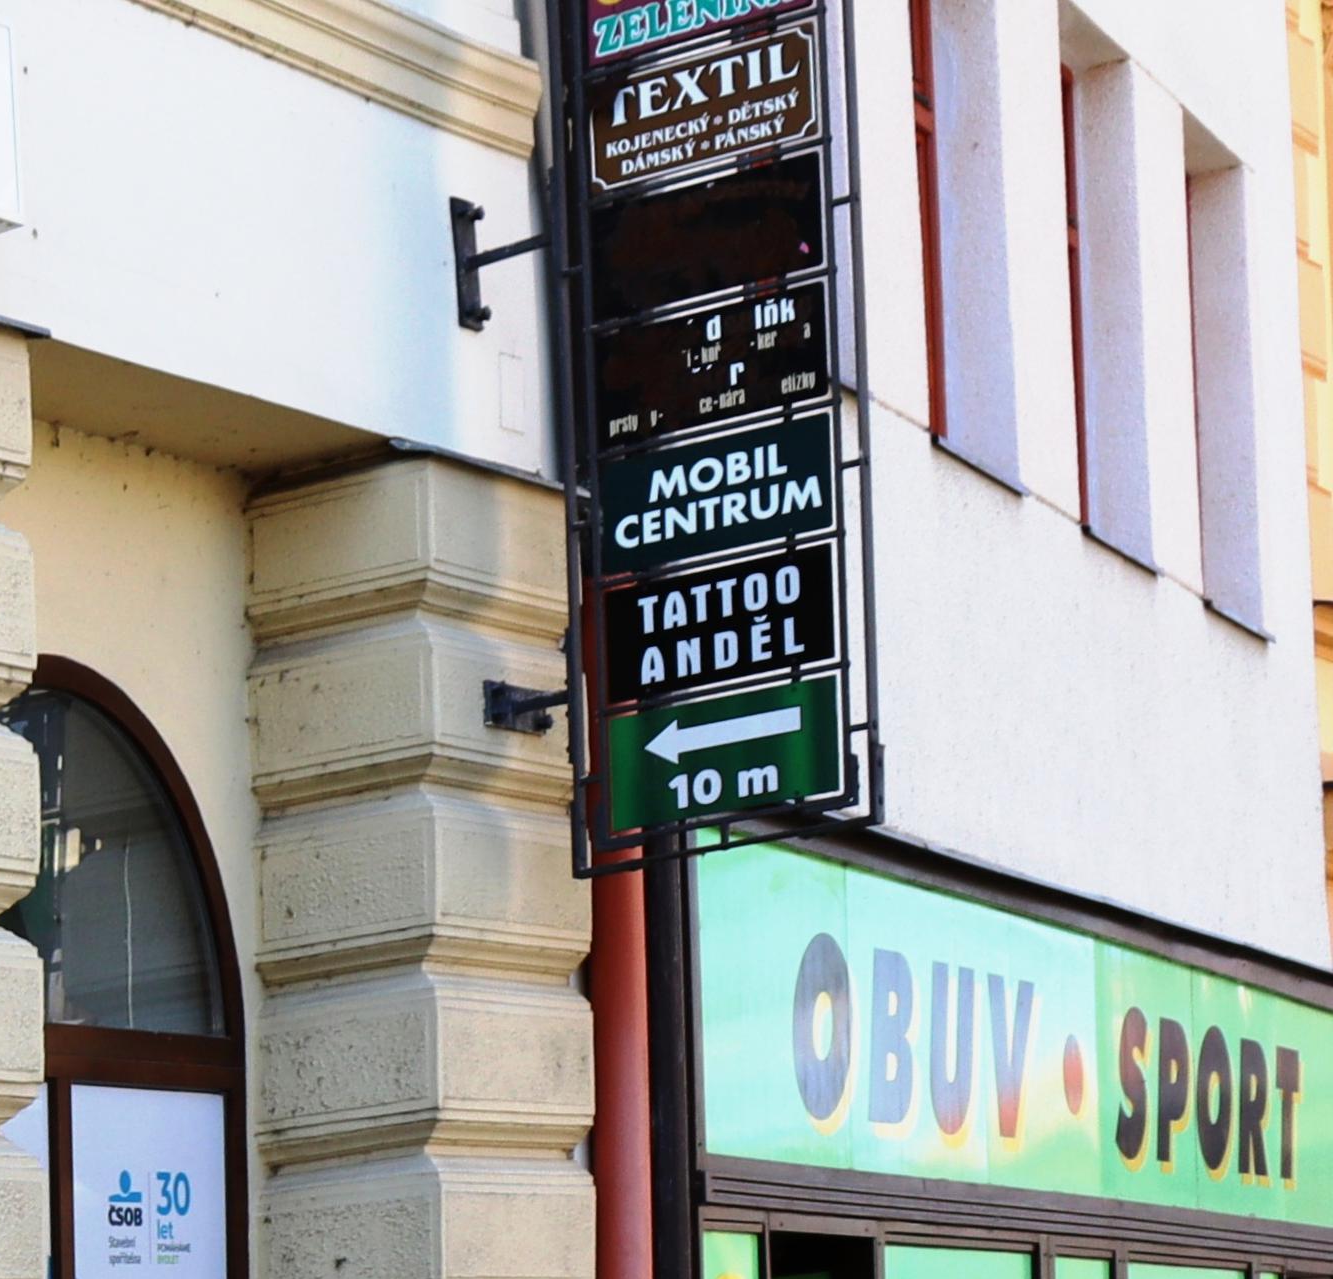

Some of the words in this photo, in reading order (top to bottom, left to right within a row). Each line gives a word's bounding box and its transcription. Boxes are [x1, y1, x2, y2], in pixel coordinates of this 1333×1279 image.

[611, 43, 801, 127] TEXTIL
[606, 112, 711, 158] KOJENECKÝ
[728, 87, 799, 125] DĚTSKÝ
[621, 139, 696, 175] DÁMSKÝ
[714, 114, 785, 150] PÁNSKÝ
[648, 443, 788, 503] MOBIL
[614, 475, 823, 549] CENTRUM
[637, 565, 802, 635] TATTOO
[640, 613, 805, 686] ANDĚL
[668, 766, 723, 810] 10
[737, 764, 780, 798] m
[793, 932, 1037, 1150] OBUV
[1115, 1006, 1301, 1189] SPORT
[108, 1204, 143, 1226] ČSOB
[156, 1172, 191, 1216] 30
[157, 1220, 174, 1240] let
